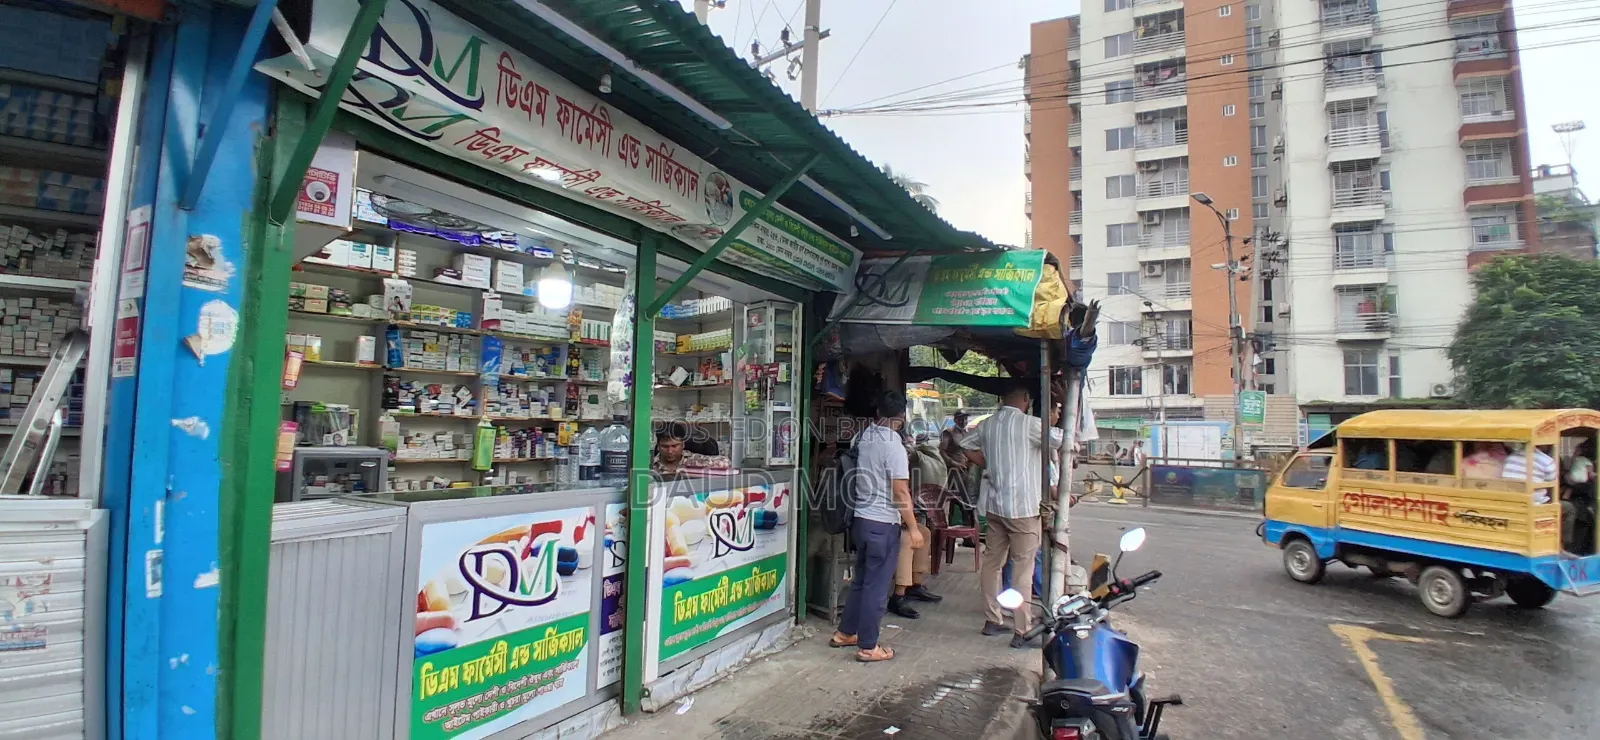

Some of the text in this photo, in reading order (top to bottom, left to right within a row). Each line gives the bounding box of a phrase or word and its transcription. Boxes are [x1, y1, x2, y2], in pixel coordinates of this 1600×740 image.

[454, 126, 530, 163] ডিএম
[520, 156, 601, 188] ফার্মসী
[496, 51, 699, 202] ডিএম ফার্মেসী এন্ড সার্জিক্যাল
[994, 262, 1036, 282] সার্জিক্যাল
[674, 590, 699, 625] ডিএম
[700, 575, 729, 613] ফার্মেসী
[730, 580, 743, 602] এন্ড
[745, 565, 777, 596] সার্জিক্যাল
[420, 661, 460, 701] ডিএম
[462, 640, 508, 685] ফার্মেসী
[510, 642, 531, 670] এন্ড
[533, 624, 584, 661] সার্জিক্যাল
